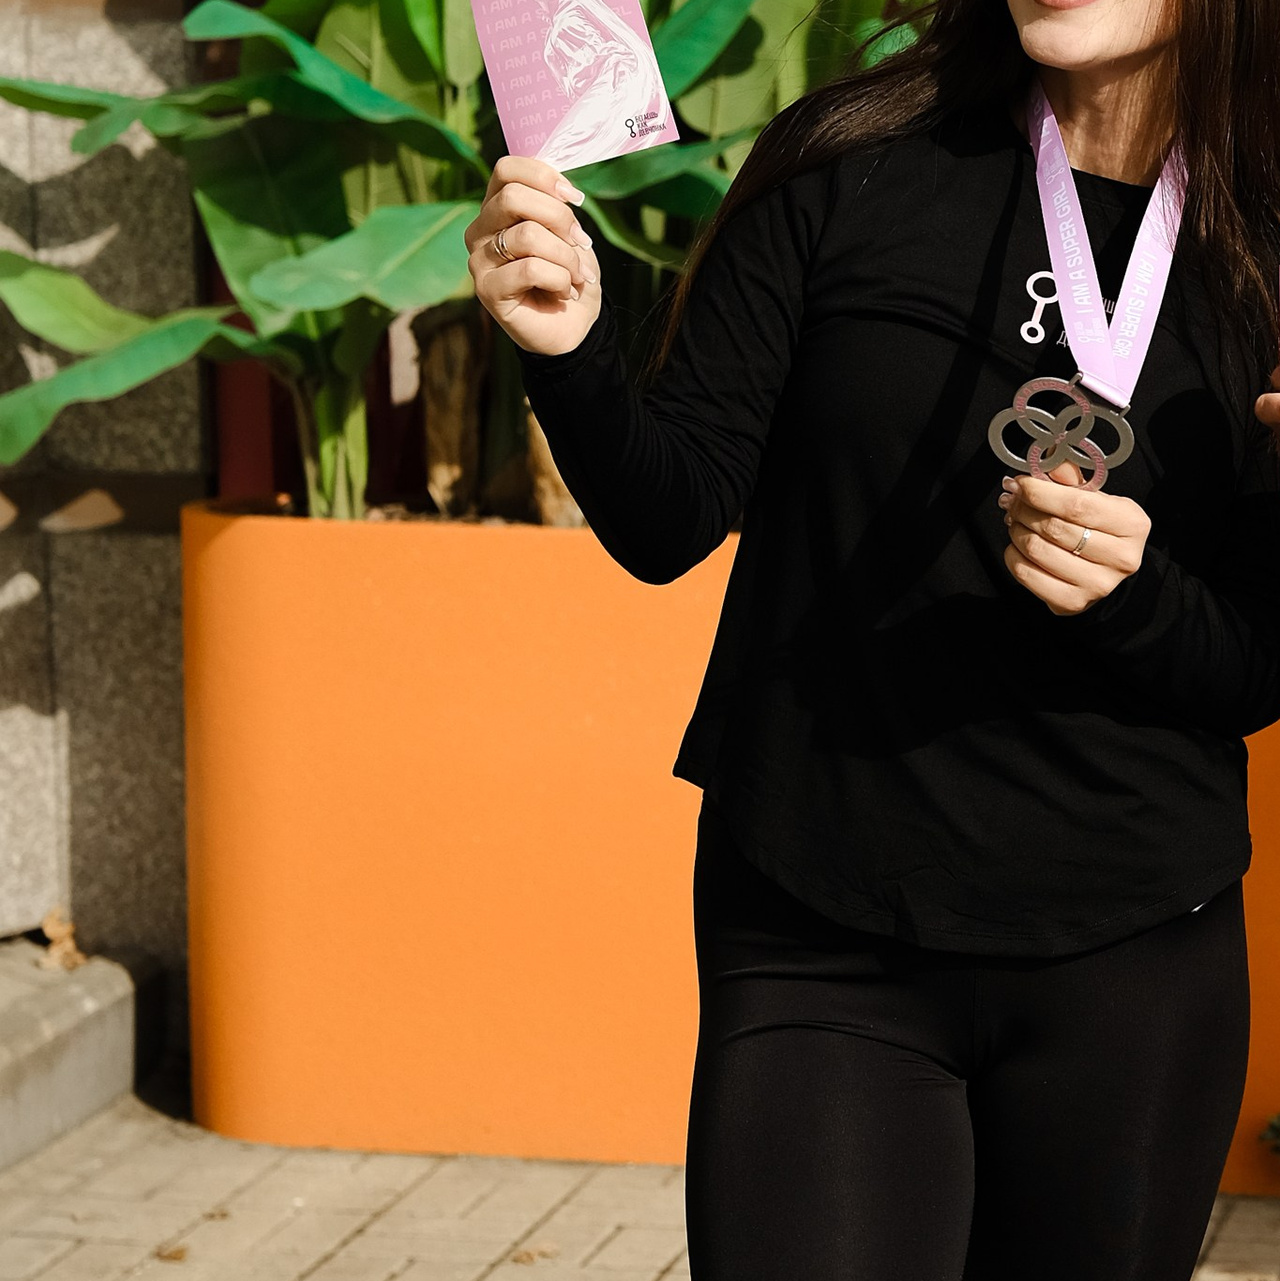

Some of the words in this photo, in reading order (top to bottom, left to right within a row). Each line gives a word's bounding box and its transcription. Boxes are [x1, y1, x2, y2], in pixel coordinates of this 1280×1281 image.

[495, 17, 517, 32] AM
[522, 12, 532, 24] A
[500, 36, 522, 51] AM
[527, 31, 536, 43] A
[505, 56, 527, 70] AM
[531, 51, 542, 62] A
[510, 75, 532, 90] AM
[536, 70, 547, 82] A
[515, 94, 537, 109] AM
[541, 89, 552, 101] A
[519, 113, 542, 128] AM
[547, 109, 557, 120] A
[1052, 181, 1071, 219] GIRL
[1059, 217, 1083, 268] SUPER
[1142, 250, 1157, 261] I
[1068, 268, 1087, 280] A
[1135, 258, 1155, 285] AM
[1071, 282, 1093, 306] AM
[1131, 283, 1149, 297] A
[1118, 297, 1145, 338] SUPER
